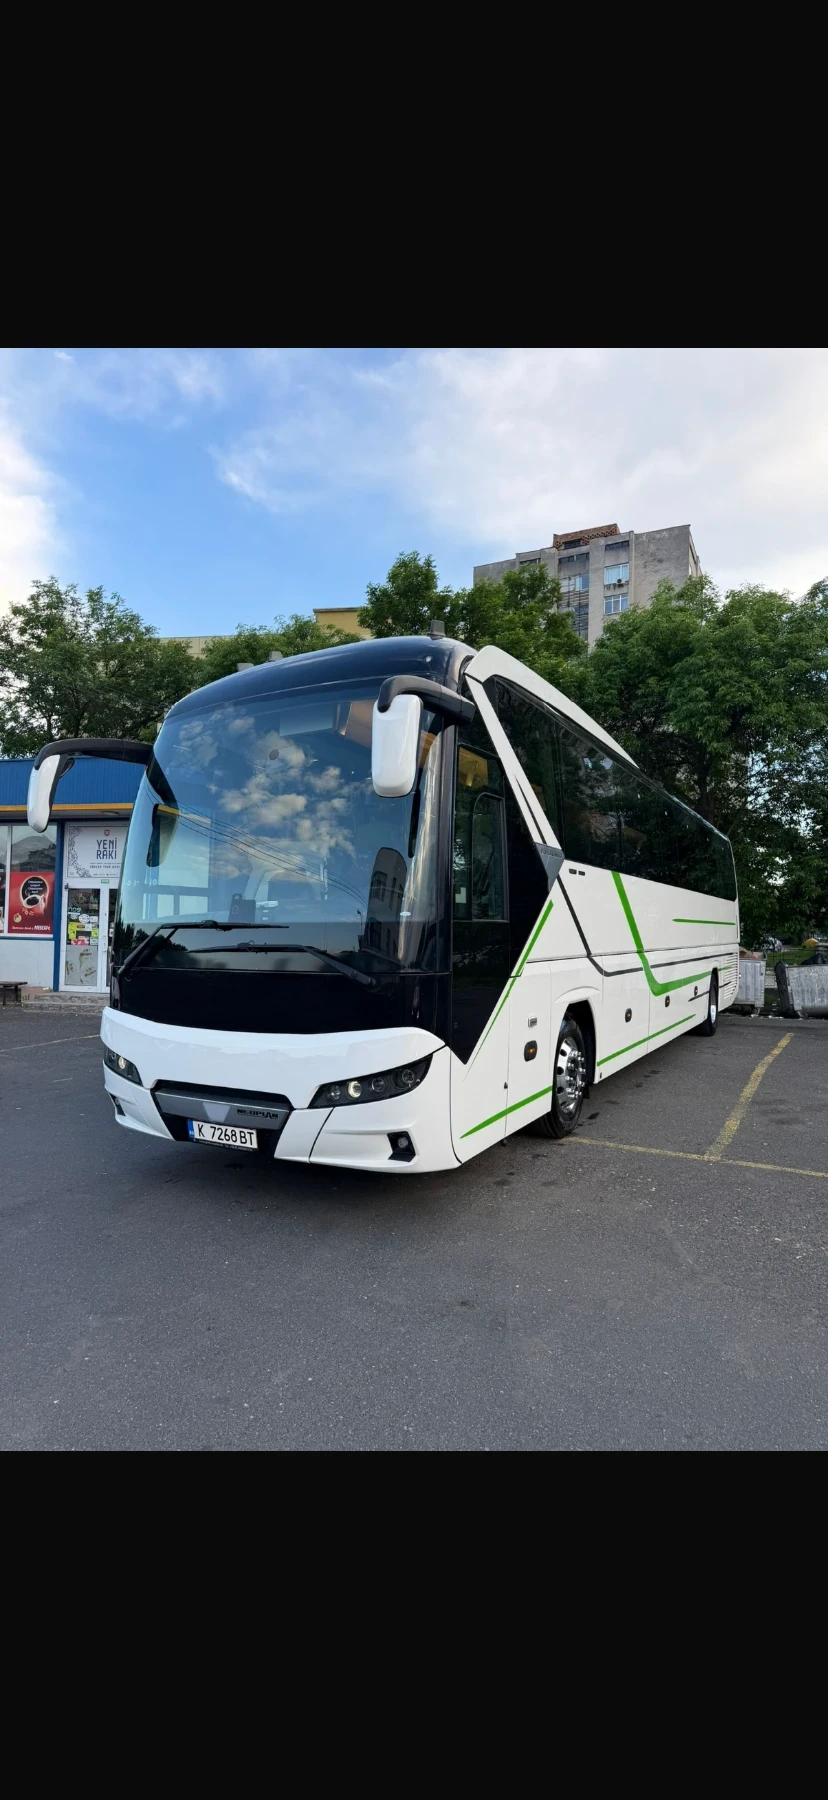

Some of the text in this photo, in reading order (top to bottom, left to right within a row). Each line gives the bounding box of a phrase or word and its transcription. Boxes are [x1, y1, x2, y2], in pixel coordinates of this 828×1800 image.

[96, 838, 118, 850] YENİ
[96, 850, 117, 860] RAKI
[236, 1109, 279, 1119] NEOPLAN
[197, 1123, 205, 1138] K
[210, 1126, 237, 1143] 7268
